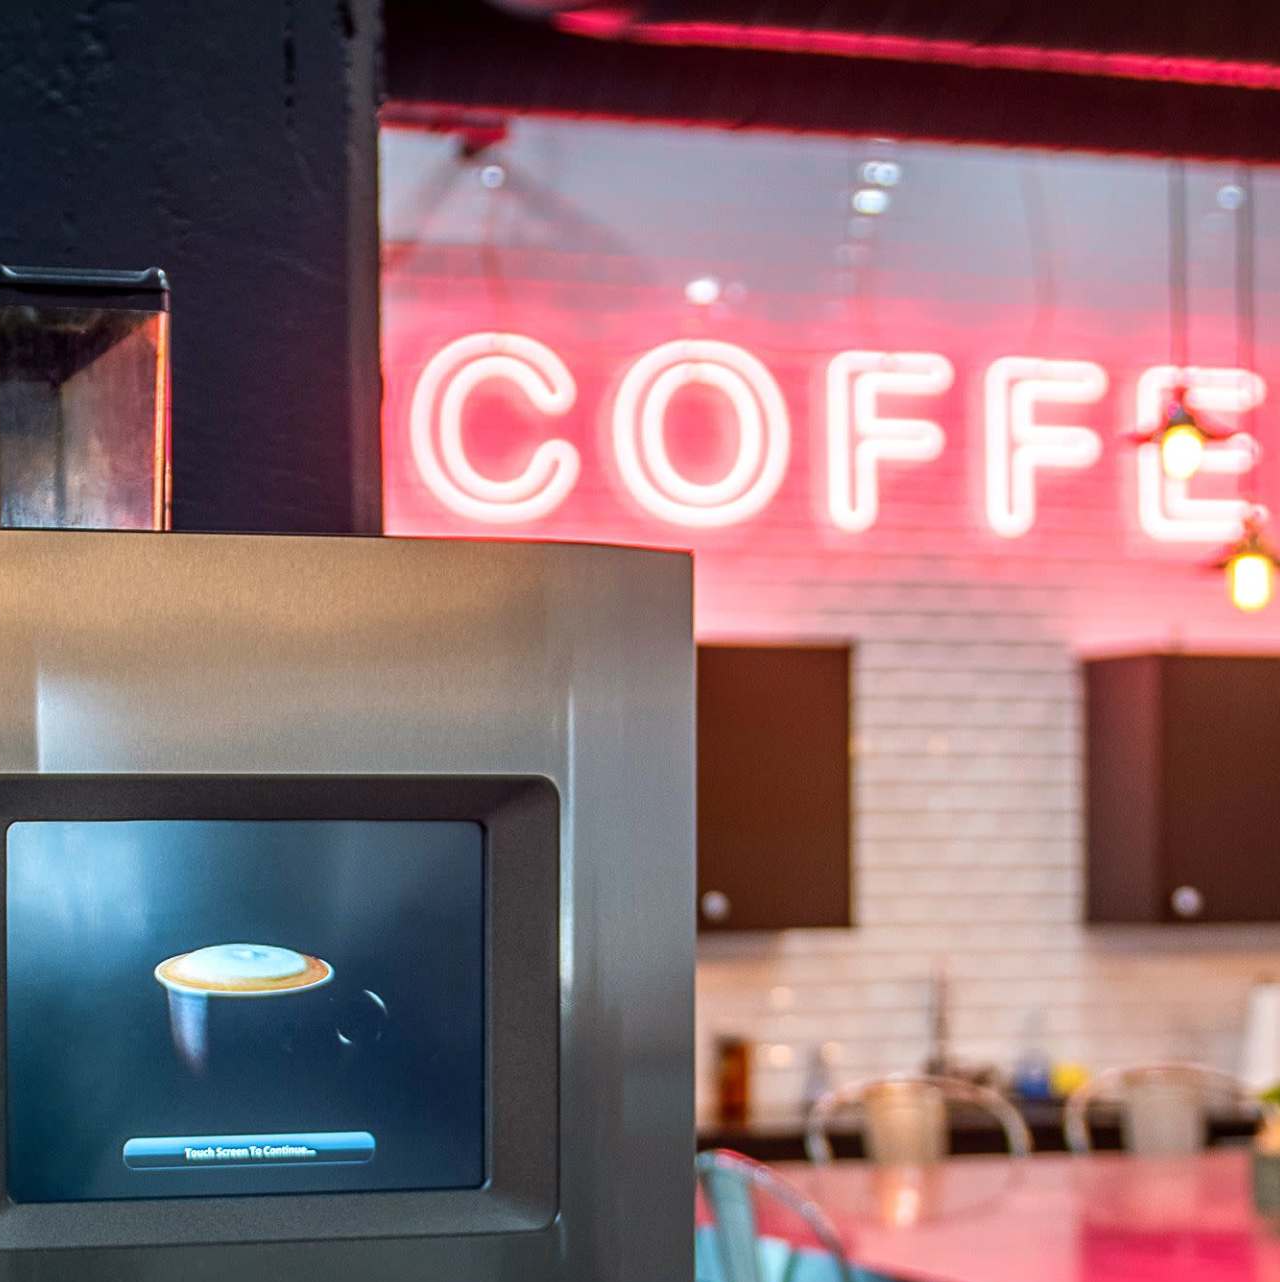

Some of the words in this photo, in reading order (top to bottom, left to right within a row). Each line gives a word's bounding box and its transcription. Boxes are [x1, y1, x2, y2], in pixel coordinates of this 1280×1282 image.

[184, 1146, 215, 1160] Touch
[216, 1146, 249, 1159] Screen
[249, 1145, 263, 1158] To
